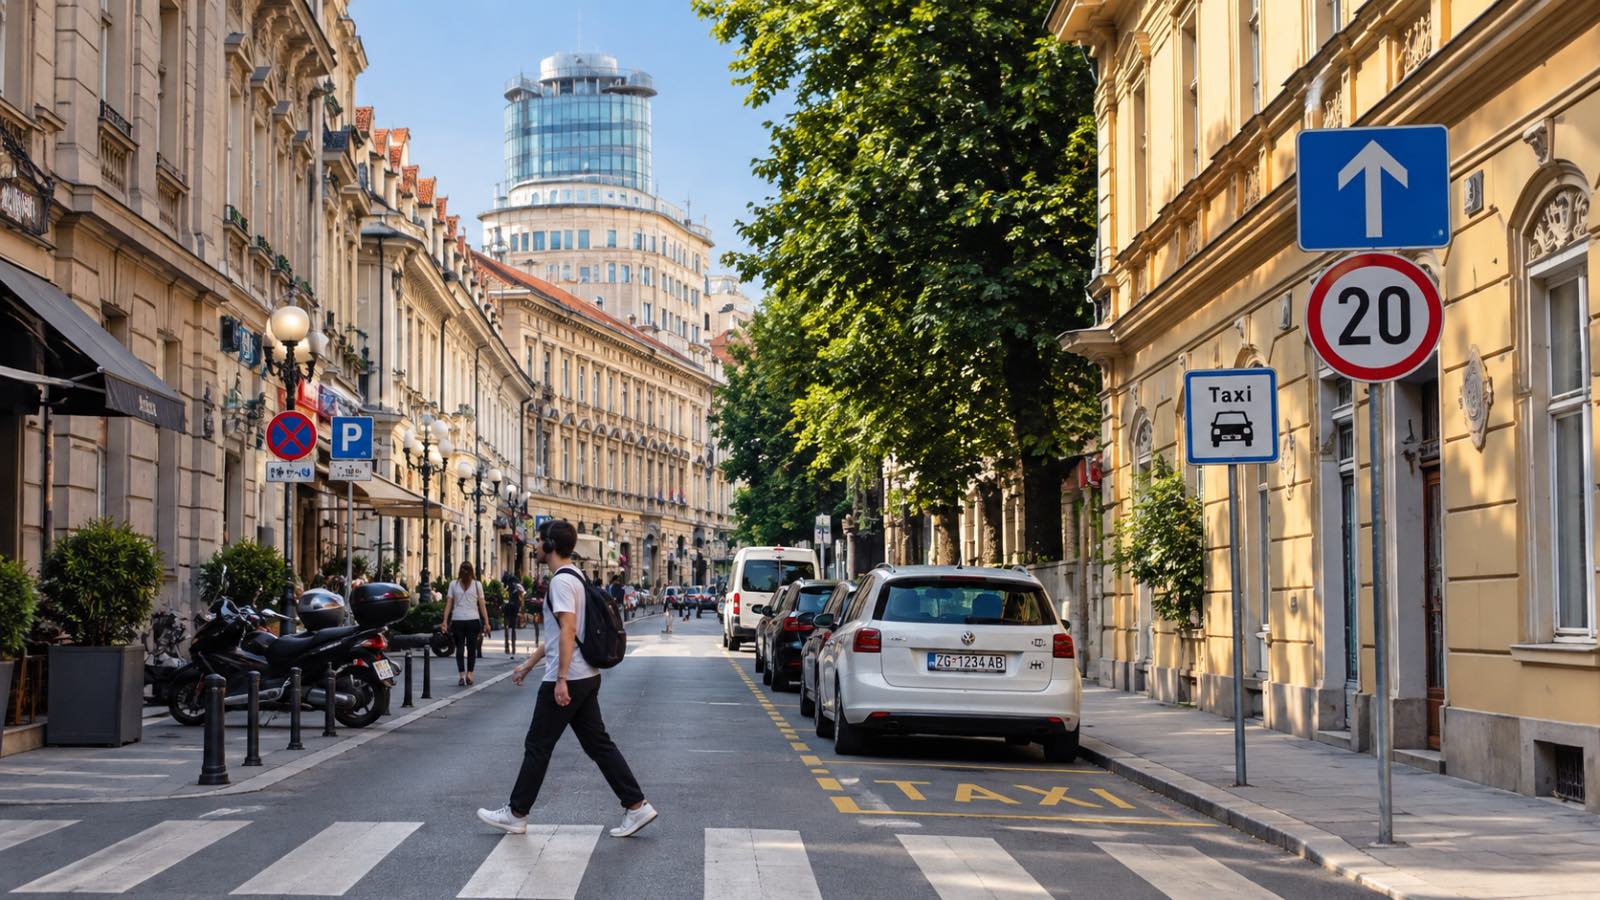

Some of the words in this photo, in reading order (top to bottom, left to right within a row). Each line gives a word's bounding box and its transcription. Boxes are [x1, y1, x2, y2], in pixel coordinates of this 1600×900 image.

[1338, 286, 1411, 346] 20
[1208, 385, 1252, 403] Taxi
[342, 423, 362, 452] P
[937, 655, 951, 667] ZG
[958, 655, 985, 668] 1234
[988, 656, 1003, 669] AB
[873, 780, 1137, 809] TAXI
